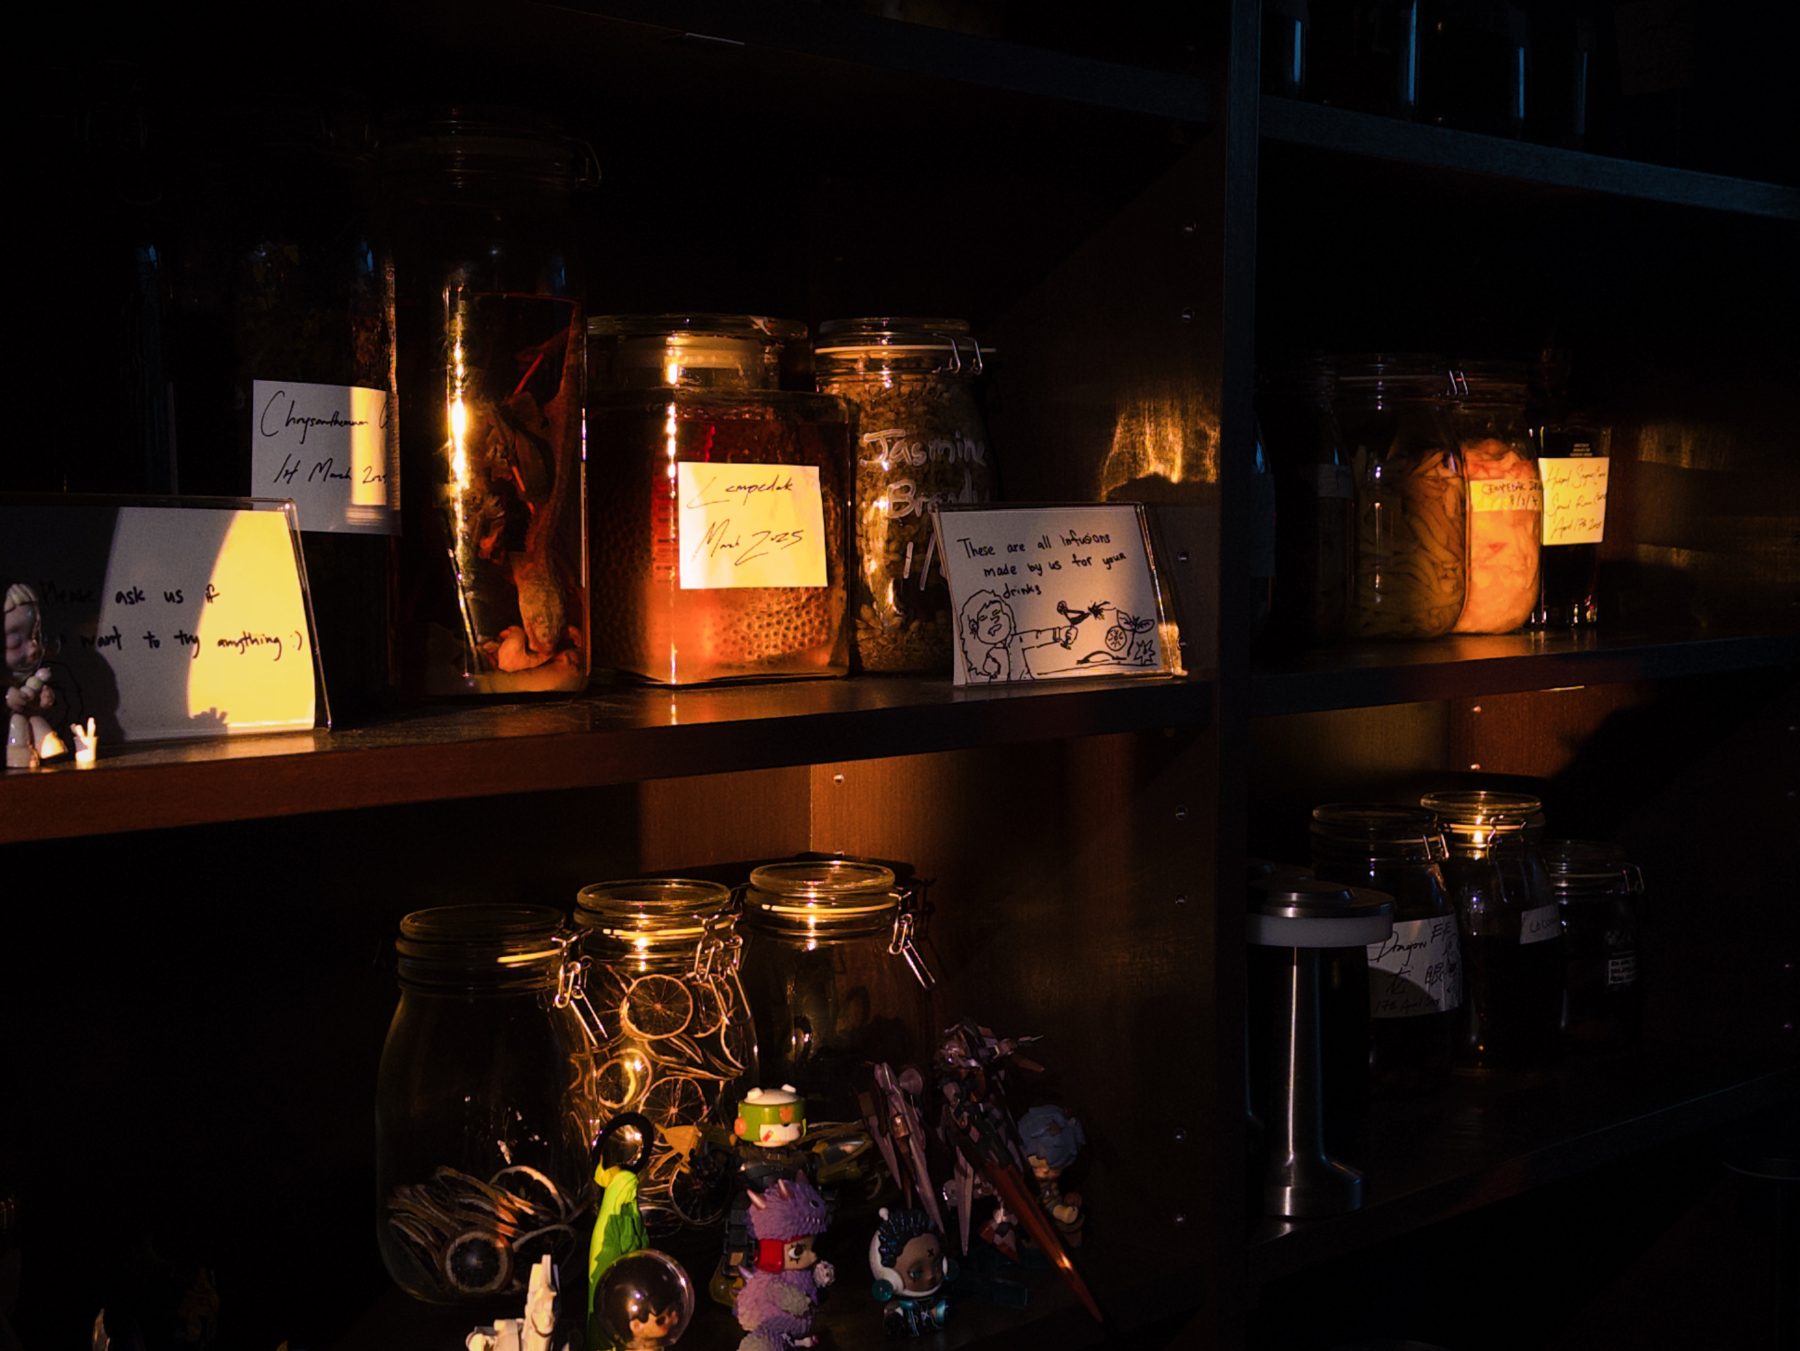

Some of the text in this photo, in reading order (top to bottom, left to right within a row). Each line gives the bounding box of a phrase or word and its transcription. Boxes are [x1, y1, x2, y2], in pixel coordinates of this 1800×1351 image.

[957, 537, 996, 558] These
[1007, 542, 1026, 552] are
[1037, 534, 1052, 550] all
[984, 563, 1018, 577] made
[1027, 562, 1043, 577] by
[1049, 561, 1063, 571] us
[1072, 554, 1092, 567] for
[115, 586, 146, 604] ask
[164, 588, 184, 604] us
[205, 584, 220, 604] if
[1002, 582, 1042, 599] drinks
[80, 626, 122, 651] want
[143, 630, 160, 649] to
[174, 630, 200, 659] try
[217, 631, 282, 661] anything
